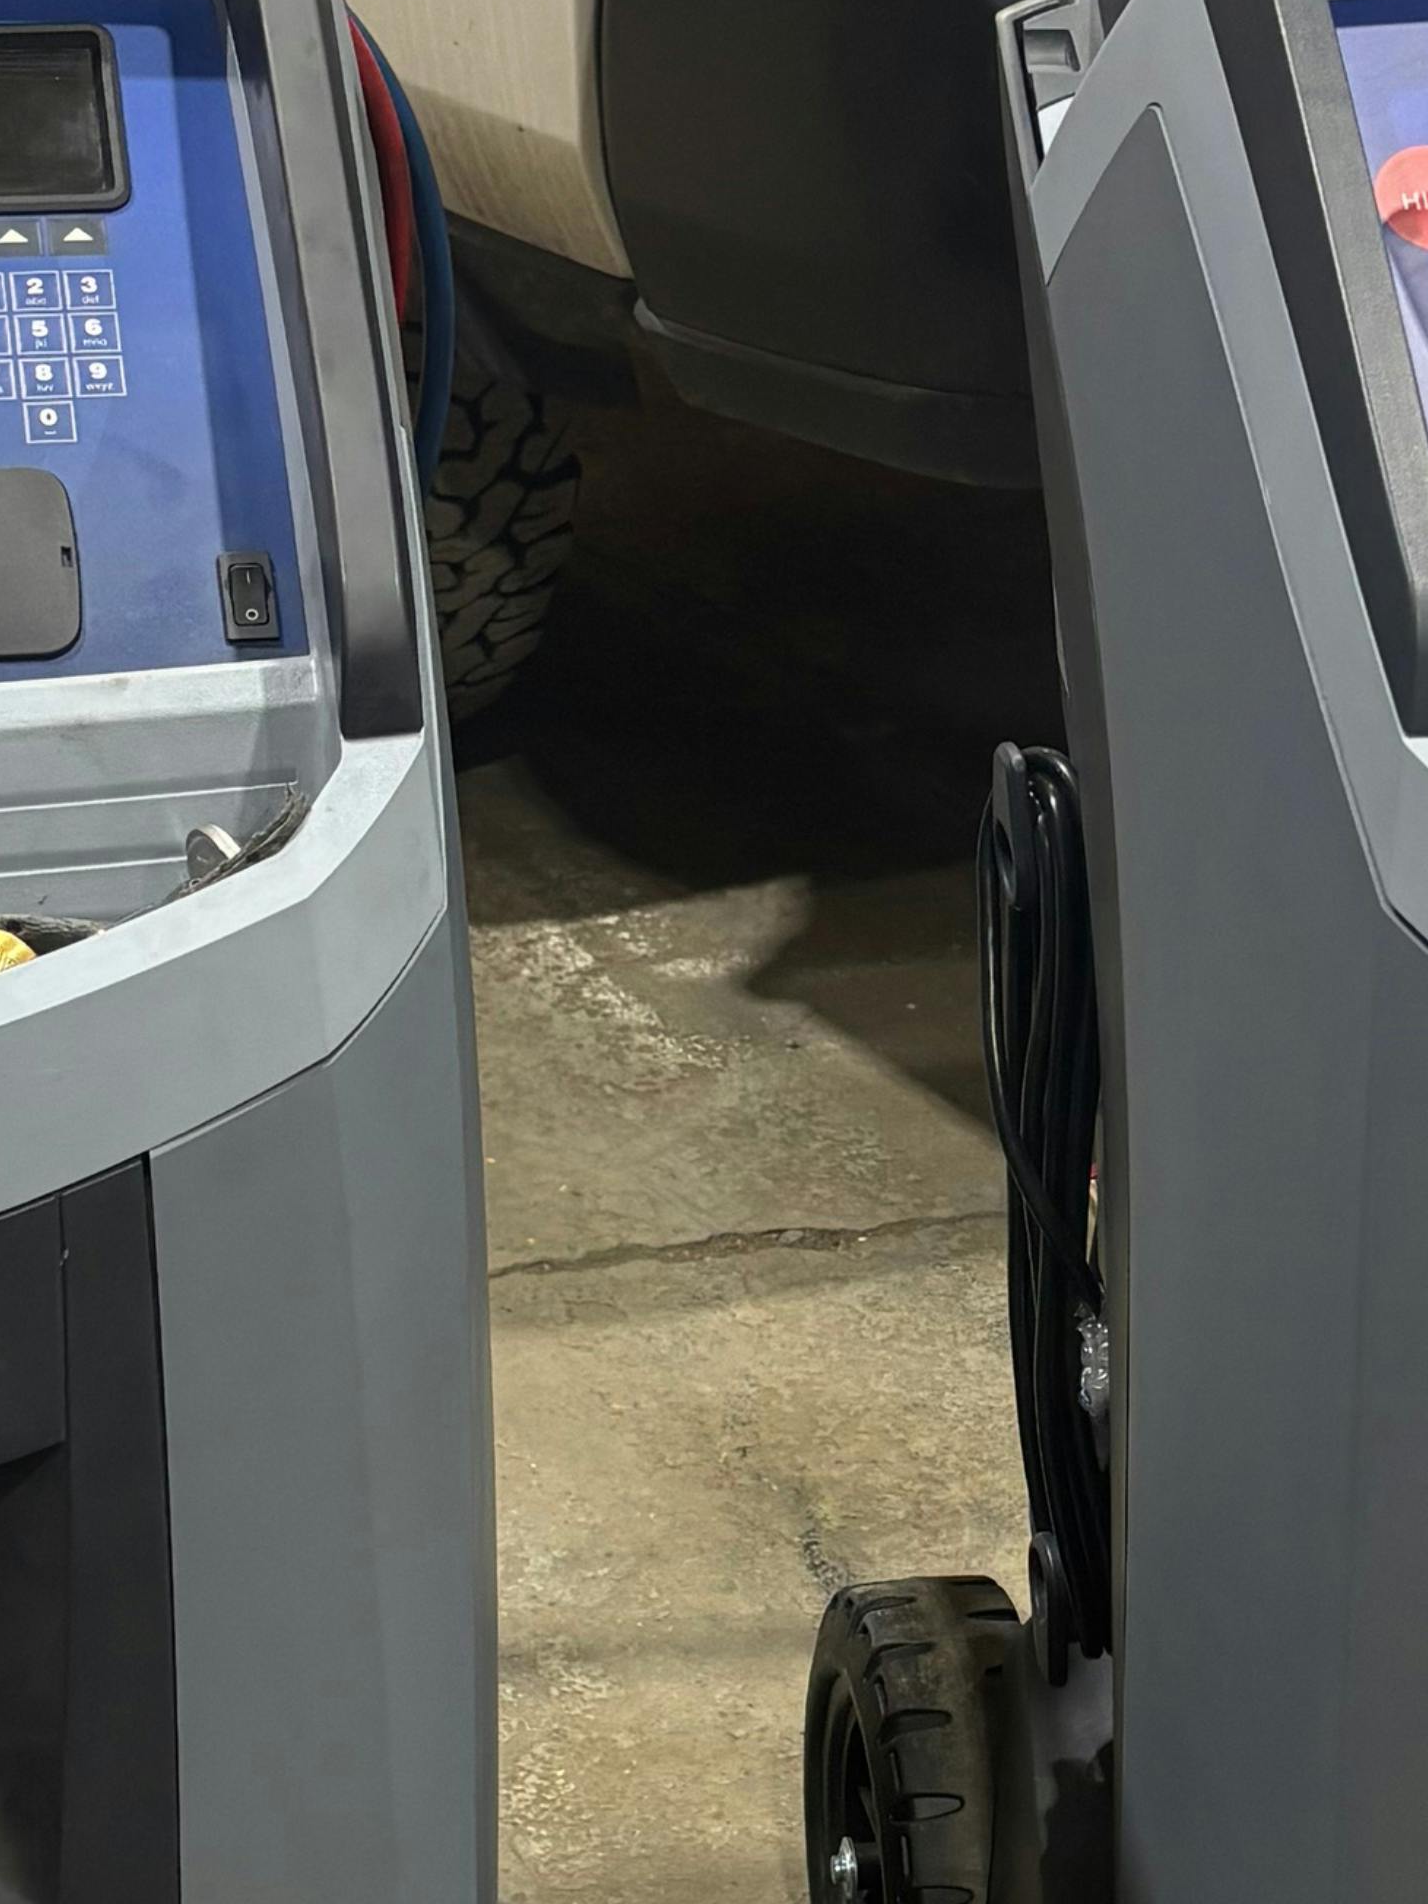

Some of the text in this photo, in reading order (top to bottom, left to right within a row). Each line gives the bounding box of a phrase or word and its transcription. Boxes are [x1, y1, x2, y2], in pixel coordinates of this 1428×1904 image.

[26, 277, 44, 295] 2
[80, 276, 98, 293] 3
[31, 319, 49, 337] 5
[84, 318, 103, 336] 6
[34, 363, 53, 381] 8
[88, 362, 108, 380] 9
[39, 408, 58, 426] 0
